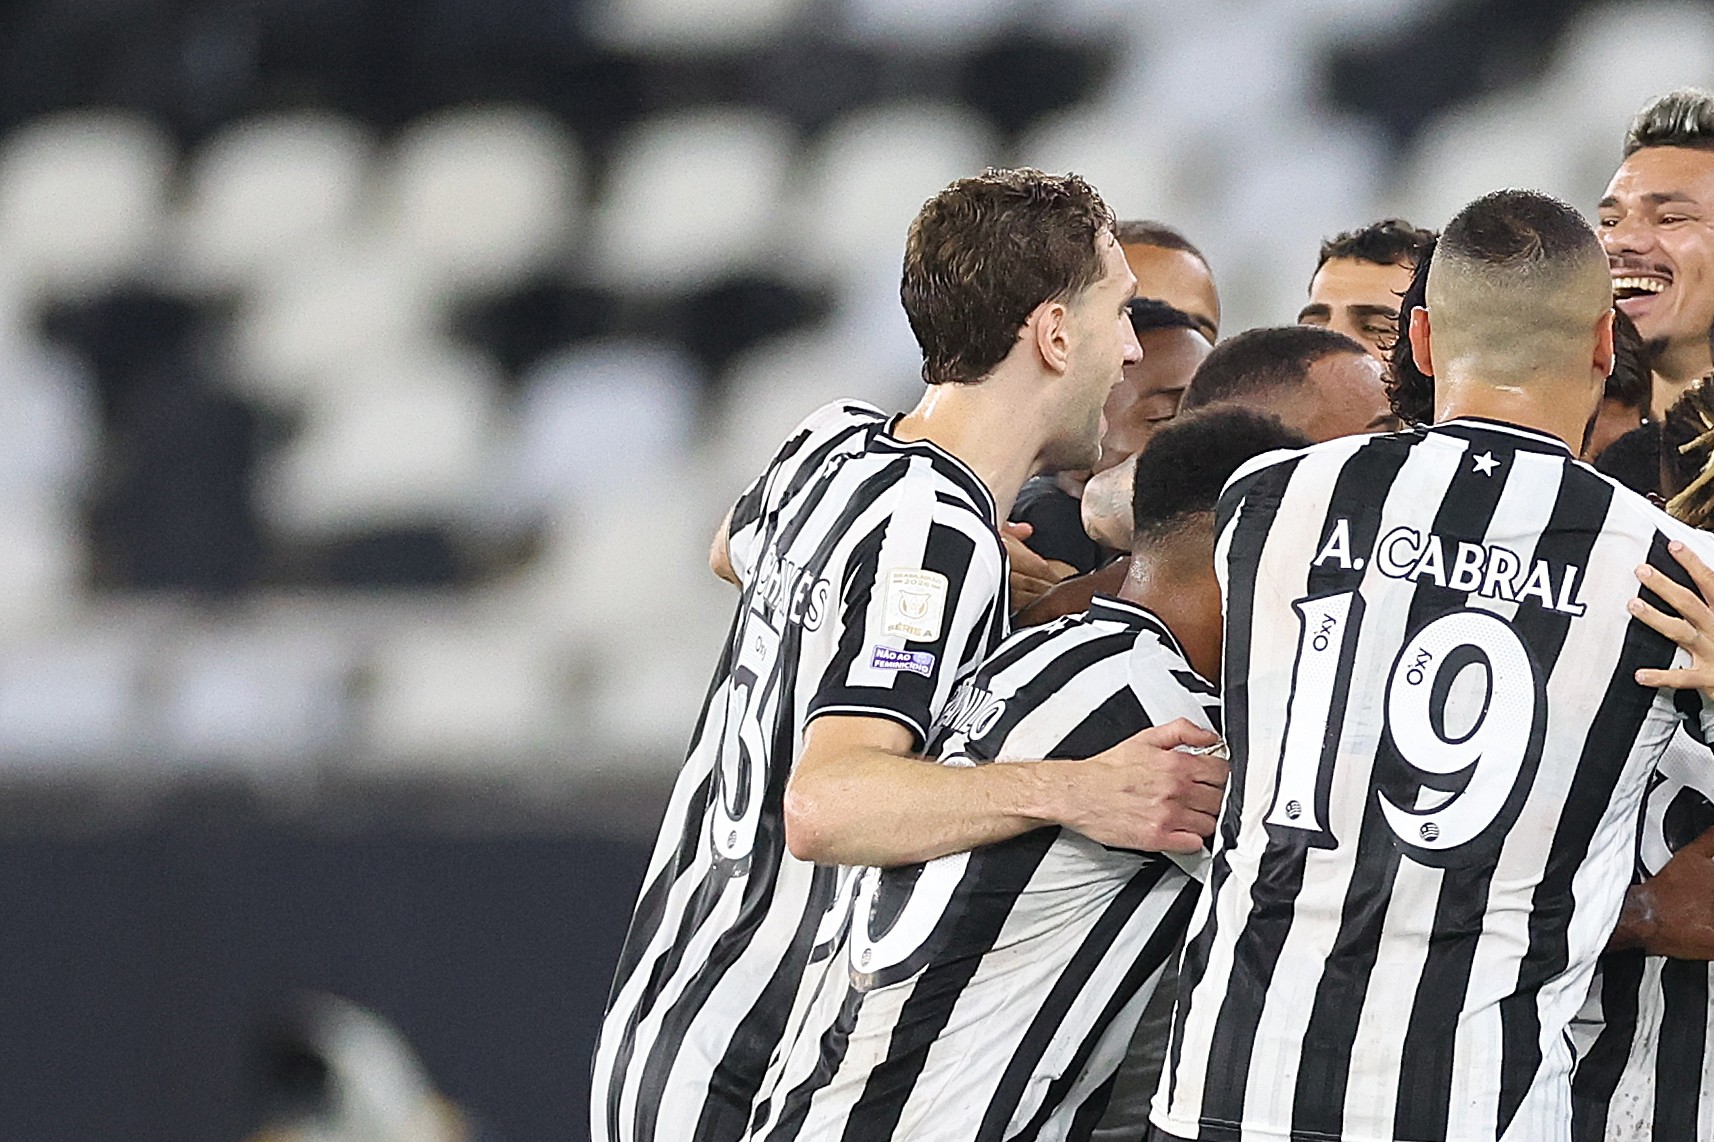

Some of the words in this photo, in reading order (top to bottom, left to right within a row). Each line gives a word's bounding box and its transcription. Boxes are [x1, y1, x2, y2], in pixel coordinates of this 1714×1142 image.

[1316, 518, 1364, 570] A.
[1376, 526, 1588, 617] CABRAL
[922, 629, 933, 638] A
[1313, 612, 1337, 652] Oxy
[897, 651, 912, 661] AO
[1407, 647, 1433, 687] Oxy
[1266, 590, 1536, 850] 19
